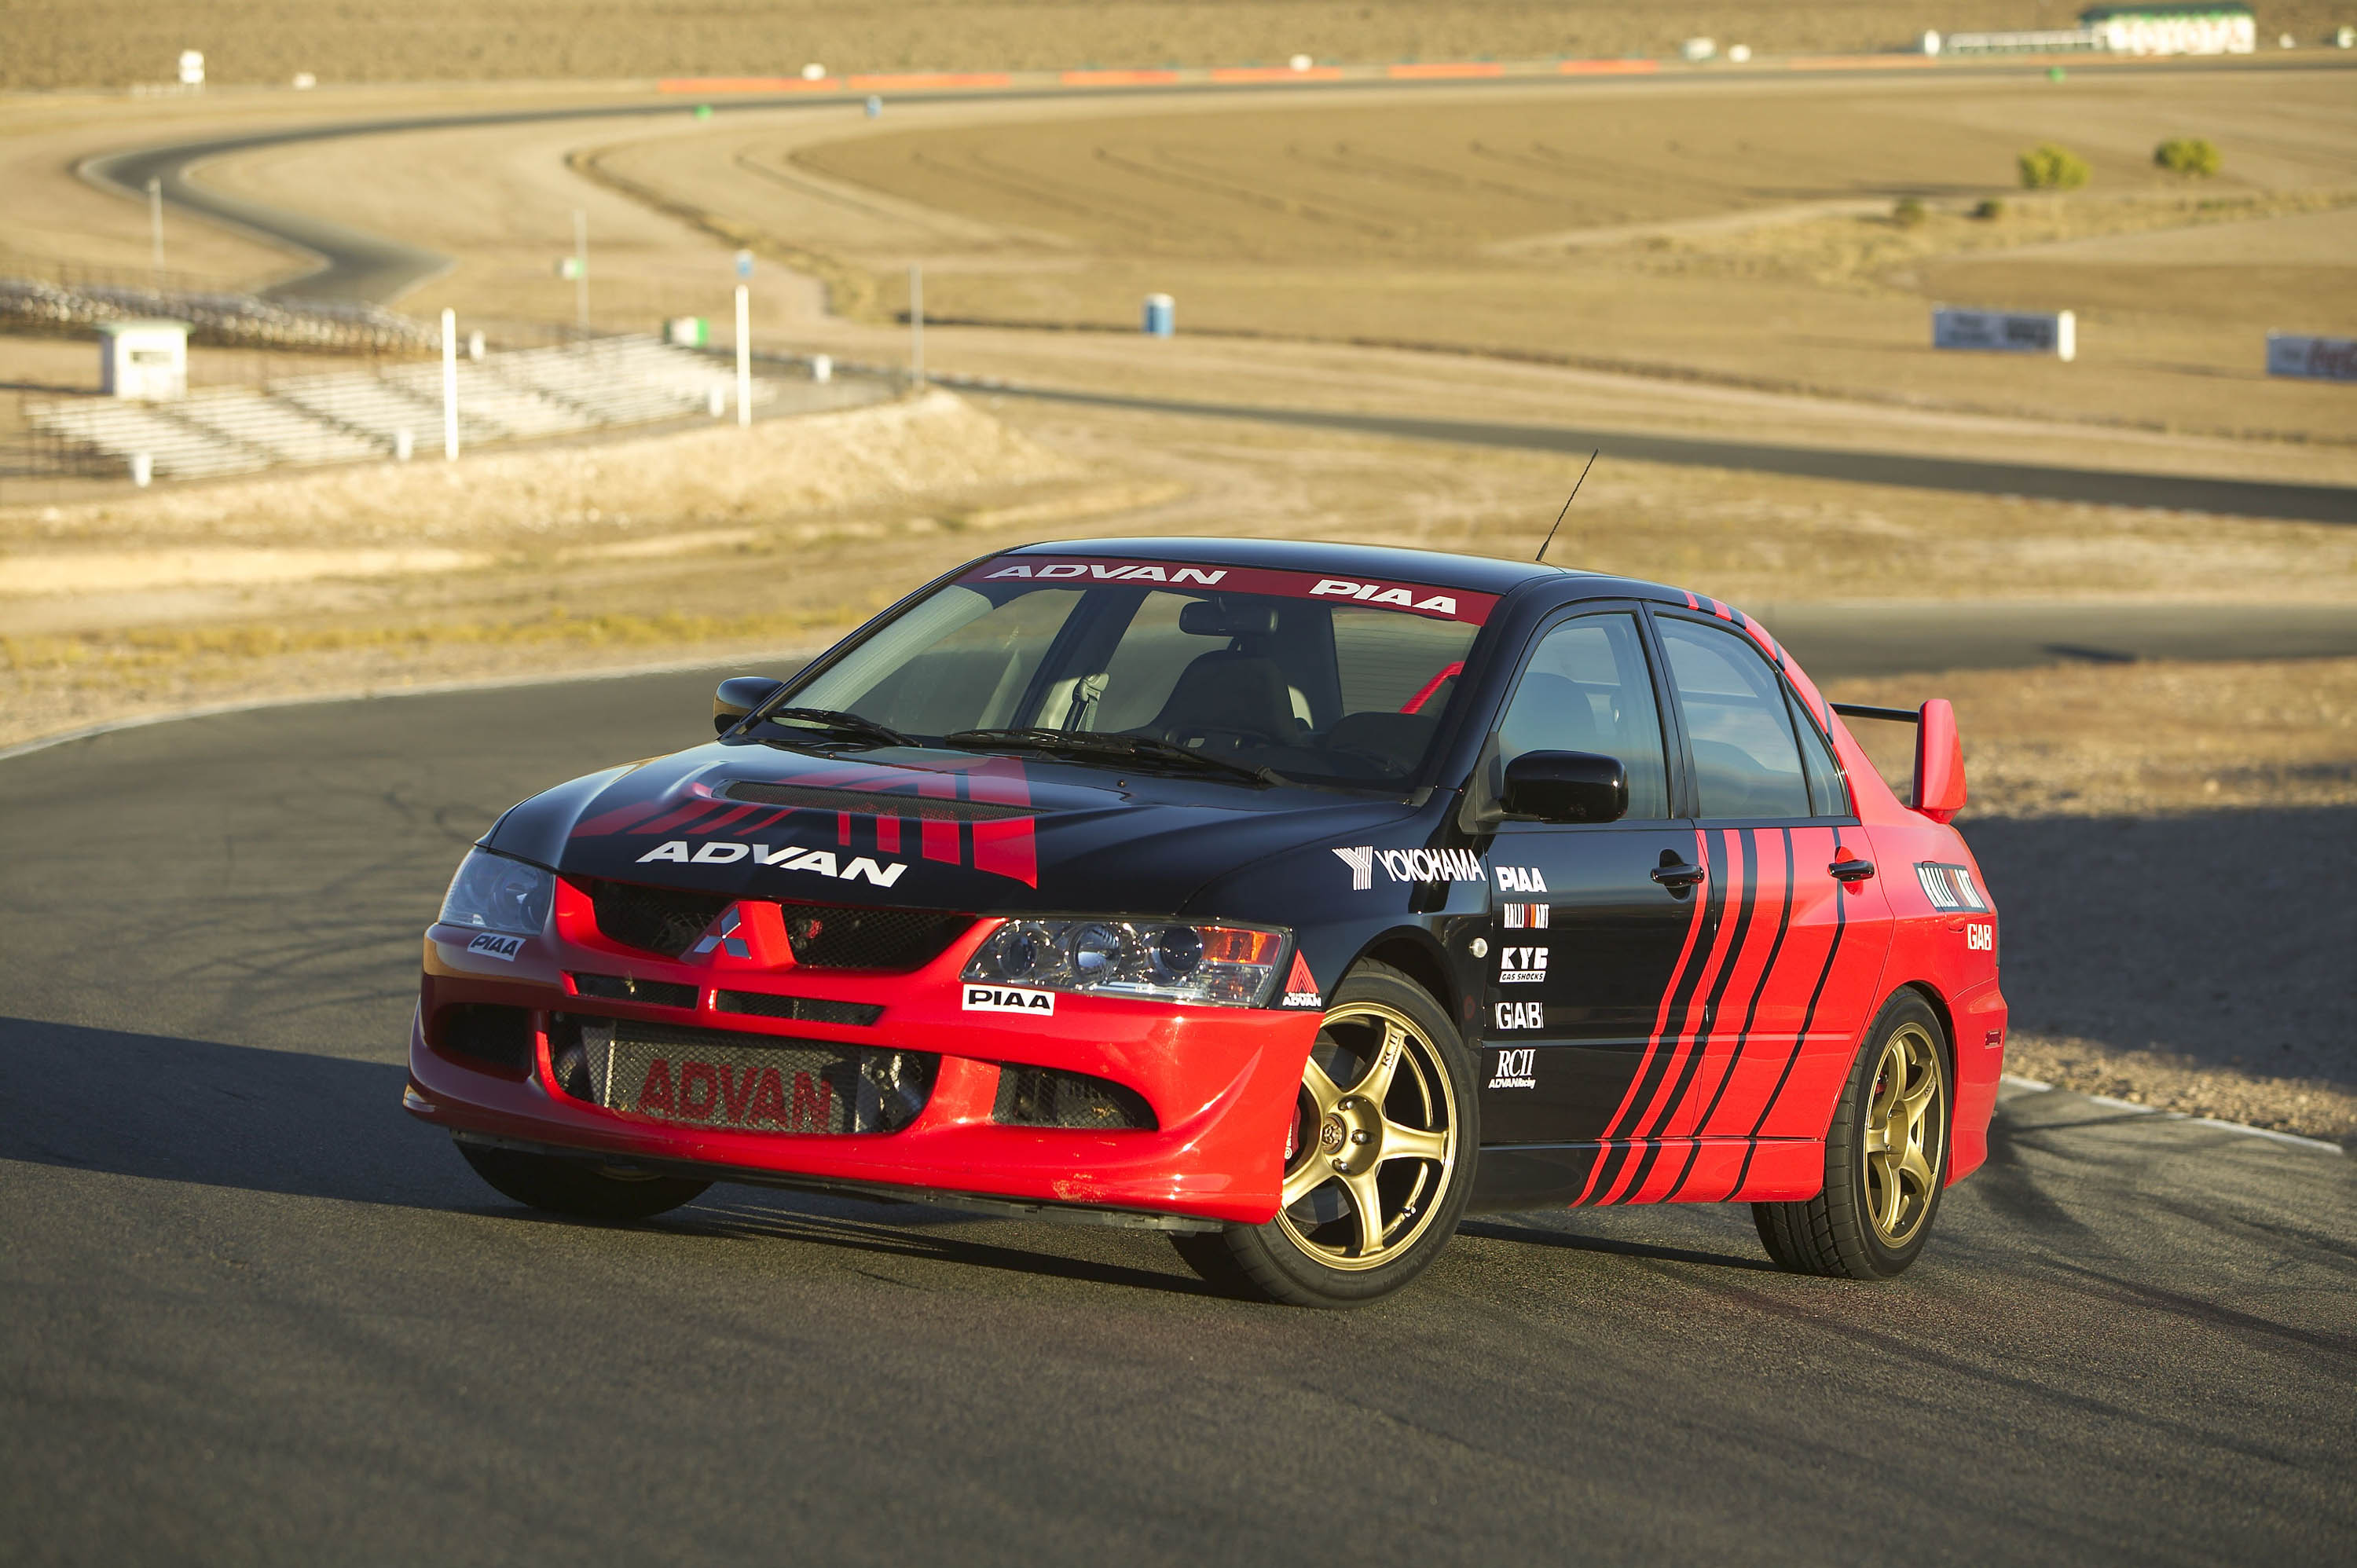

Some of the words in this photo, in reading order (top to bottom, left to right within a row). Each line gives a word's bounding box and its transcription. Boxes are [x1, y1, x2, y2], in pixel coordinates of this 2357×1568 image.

[983, 565, 1228, 585] ADVAN
[1309, 579, 1457, 614] PIAA
[635, 841, 908, 888] ADVAN
[1374, 848, 1486, 882] YOKOHAMA
[1495, 866, 1548, 892] PIAA
[471, 935, 519, 956] PIAA
[1967, 923, 1992, 951] GAB
[969, 990, 1050, 1009] PIAA
[1282, 996, 1322, 1007] ADVAN
[1495, 1002, 1544, 1030] GAB
[1495, 1049, 1536, 1078] RCII
[636, 1059, 834, 1131] ADVAN
